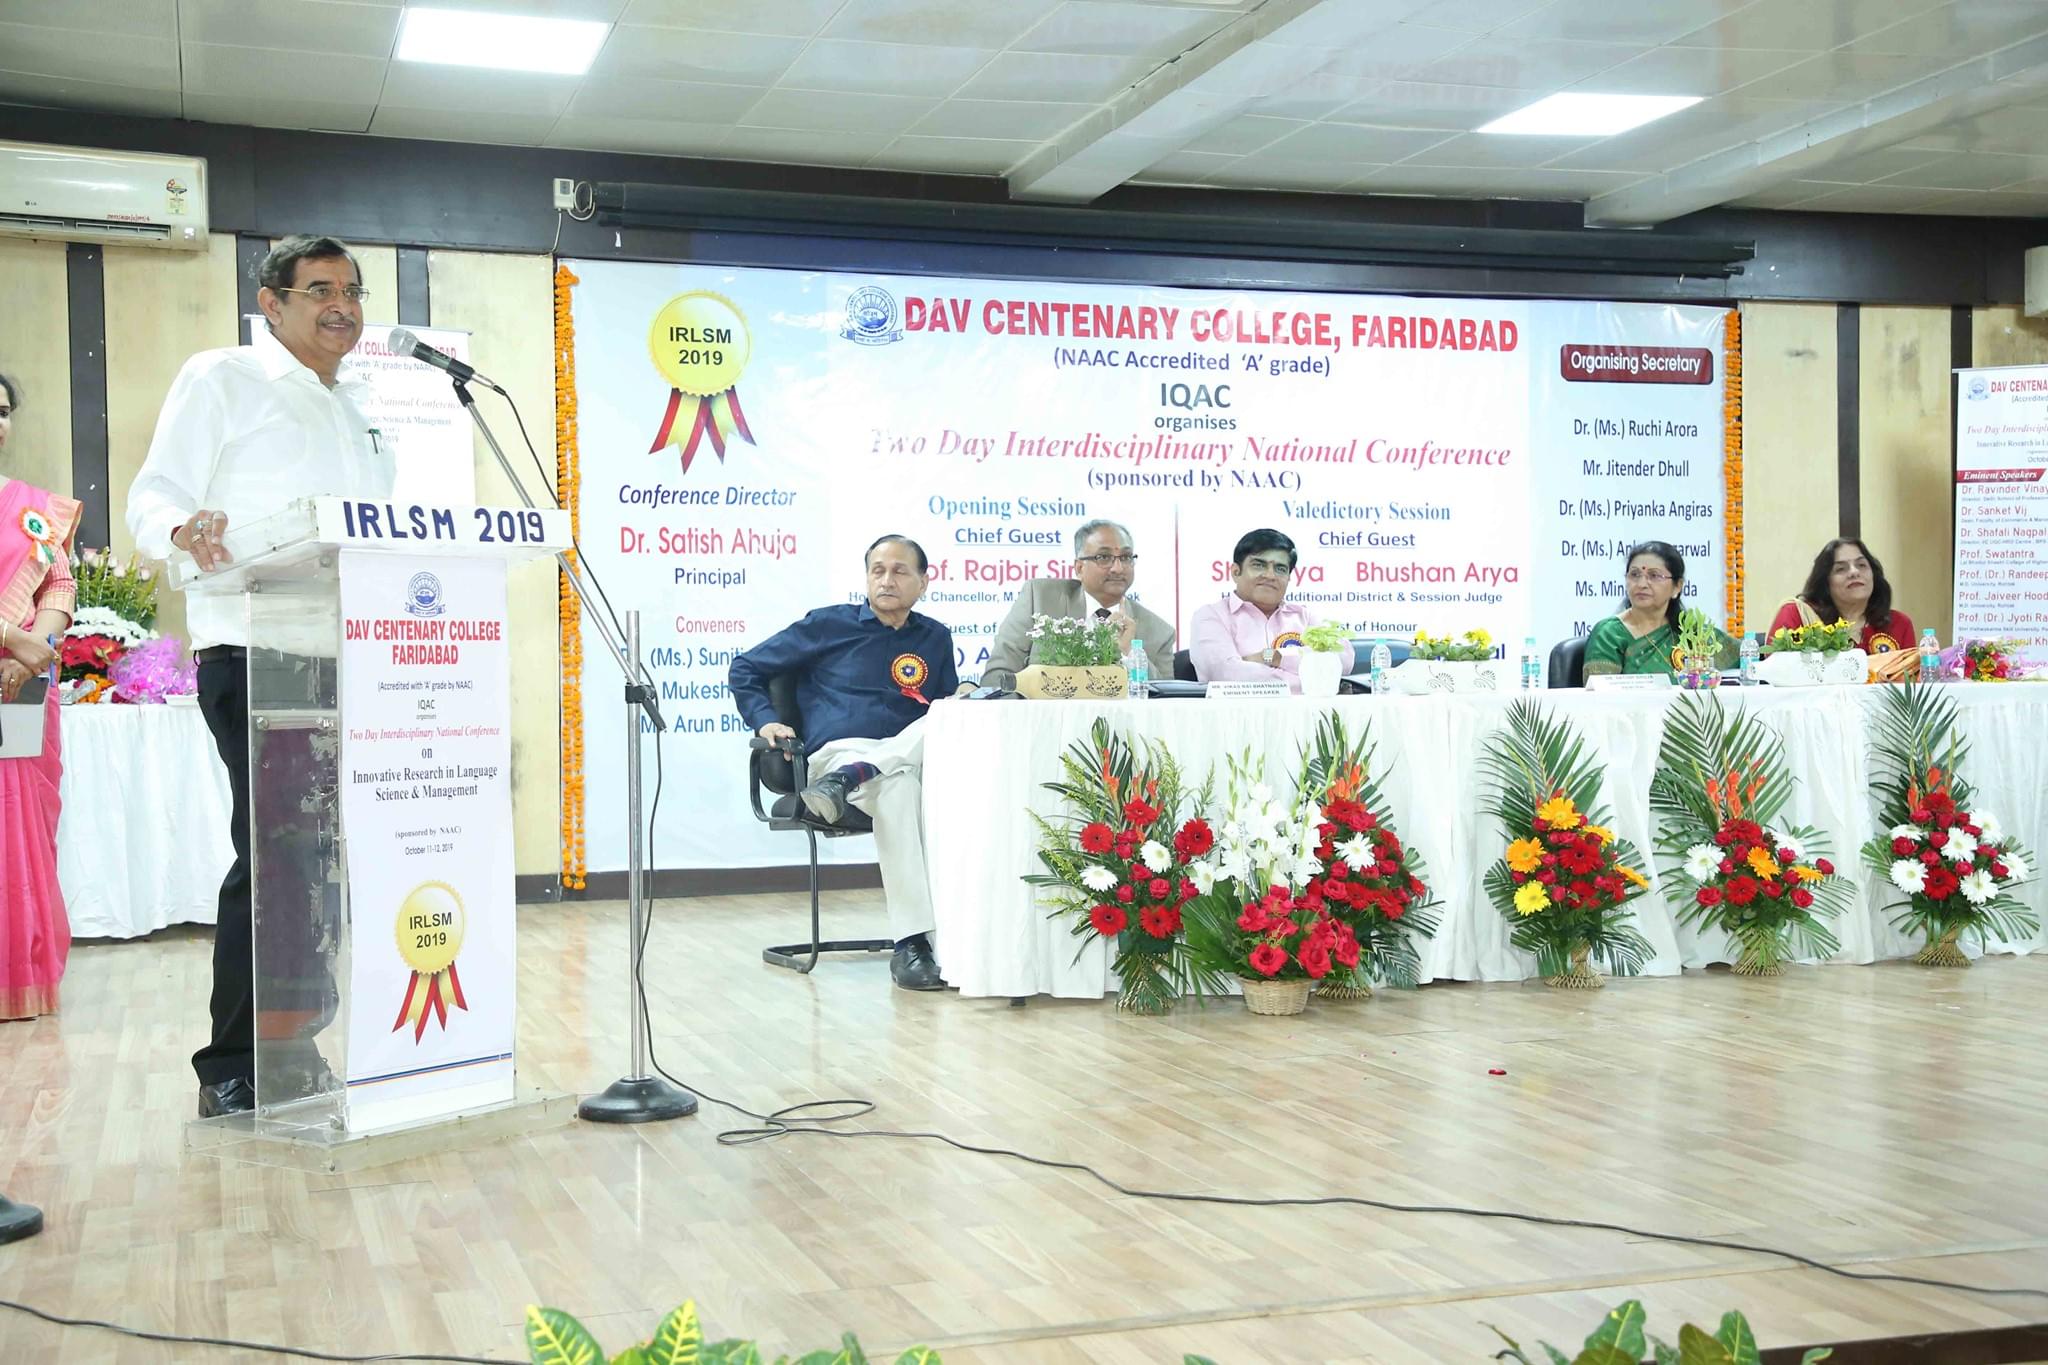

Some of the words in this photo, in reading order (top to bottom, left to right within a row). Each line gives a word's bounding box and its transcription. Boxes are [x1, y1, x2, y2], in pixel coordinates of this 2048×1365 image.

[904, 296, 972, 333] DAV
[982, 299, 1179, 340] CENTENARY
[1190, 308, 1341, 353] COLLEGE,
[1352, 314, 1518, 352] FARIDABAD
[669, 326, 731, 344] IRLSM
[679, 349, 723, 366] 2019
[1054, 347, 1119, 369] (NAAC
[1125, 350, 1230, 371] Accredited
[1269, 355, 1331, 377] grade)
[1571, 351, 1639, 374] Organising
[1641, 353, 1701, 375] Secretary
[1991, 381, 2008, 393] DAV
[2010, 379, 2048, 393] CENTENA
[380, 394, 414, 408] National
[1161, 382, 1231, 410] IQAC
[1154, 413, 1237, 433] organises
[1574, 419, 1590, 436] Dr.
[1594, 417, 1625, 440] (Ms.)
[1629, 419, 1662, 436] Ruchi
[1665, 421, 1698, 437] Arora
[871, 428, 927, 455] Two
[937, 429, 995, 463] Day
[1005, 430, 1233, 467] Interdisciplinary
[1243, 436, 1357, 463] National
[1366, 438, 1511, 471] Conference
[1583, 459, 1603, 476] Mr.
[1606, 459, 1655, 477] Jitender
[1658, 459, 1689, 477] Dhull
[1964, 471, 1998, 480] Eminent
[2000, 470, 2037, 480] Speakers
[1087, 466, 1193, 491] (sponsored
[1201, 468, 1223, 492] by
[1231, 469, 1301, 492] NAAC)
[619, 484, 720, 509] Conference
[725, 486, 797, 506] Director
[1961, 485, 1974, 494] Dr.
[1977, 484, 2020, 494] Ravinder
[928, 495, 1012, 520] Opening
[1018, 496, 1086, 517] Session
[1283, 499, 1383, 525] Valedictory
[1389, 500, 1451, 521] Session
[1559, 499, 1576, 516] Dr.
[1579, 498, 1611, 520] (Ms.)
[1614, 499, 1666, 520] Priyanka
[1668, 500, 1713, 521] Angiras
[1961, 506, 1974, 516] Dr.
[1978, 505, 2011, 516] Sanket
[2014, 505, 2027, 517] Vij
[343, 501, 456, 540] IRLSM
[474, 508, 545, 543] 2019
[955, 527, 1002, 544] Chief
[1008, 529, 1062, 545] Guest
[1319, 531, 1363, 546] Chief
[1367, 532, 1416, 547] Guest
[1960, 528, 1974, 538] Dr.
[1977, 527, 2010, 537] Shafali
[620, 526, 650, 554] Dr.
[658, 526, 723, 554] Satish
[731, 527, 797, 560] Ahuja
[1561, 540, 1578, 556] Dr.
[1582, 538, 1613, 560] (Ms.)
[1960, 549, 1982, 559] Prof.
[1985, 549, 2035, 559] Swatantra
[675, 567, 746, 589] Principal
[928, 559, 954, 581] of.
[965, 559, 1040, 586] Rajbir
[1356, 561, 1456, 583] Bhushan
[1464, 562, 1518, 587] Arya
[1960, 569, 1982, 579] Prof.
[1985, 569, 2006, 580] (Dr.)
[931, 591, 1000, 604] Chancellor,
[1575, 580, 1598, 597] Ms.
[1959, 591, 1981, 601] Prof.
[1984, 591, 2021, 601] Jaiveer
[1286, 591, 1342, 602] dditional
[1347, 591, 1395, 603] District
[1398, 592, 1406, 603] &
[1410, 592, 1460, 603] Session
[1464, 591, 1503, 605] Judge
[675, 615, 746, 633] Conveners
[1354, 620, 1367, 632] of
[1371, 621, 1418, 632] Honour
[1958, 612, 1980, 622] Prof.
[1984, 612, 2004, 623] (Dr.)
[2007, 612, 2032, 625] Jyoti
[346, 619, 370, 641] DAV
[374, 620, 446, 641] CENTENARY
[449, 620, 501, 641] COLLEGE
[944, 622, 979, 635] uest
[983, 621, 997, 634] of
[392, 644, 459, 665] FARIDABAD
[650, 647, 693, 669] (Ms.)
[377, 681, 410, 692] (Accredited
[411, 681, 423, 690] with
[431, 681, 447, 692] grade
[447, 681, 455, 691] by
[455, 680, 473, 691] NAAC)
[662, 680, 730, 700] Mukesh
[417, 699, 435, 710] IQAC
[641, 715, 667, 733] M.
[674, 714, 715, 733] Arun
[349, 728, 363, 741] Two
[364, 728, 378, 742] Day
[380, 727, 434, 742] Interdisciplinary
[436, 725, 463, 737] National
[464, 724, 500, 738] Conference
[421, 748, 433, 759] on
[353, 768, 402, 784] Innovative
[404, 765, 444, 781] Research
[446, 765, 455, 779] in
[457, 763, 498, 780] Language
[375, 785, 409, 801] Science
[411, 786, 420, 799] &
[422, 784, 478, 800] Management
[395, 827, 428, 839] (sponsored
[429, 827, 437, 838] by
[439, 825, 462, 836] NAAC)
[405, 845, 426, 856] October
[409, 911, 452, 930] IRLSM
[416, 931, 447, 949] 2019
